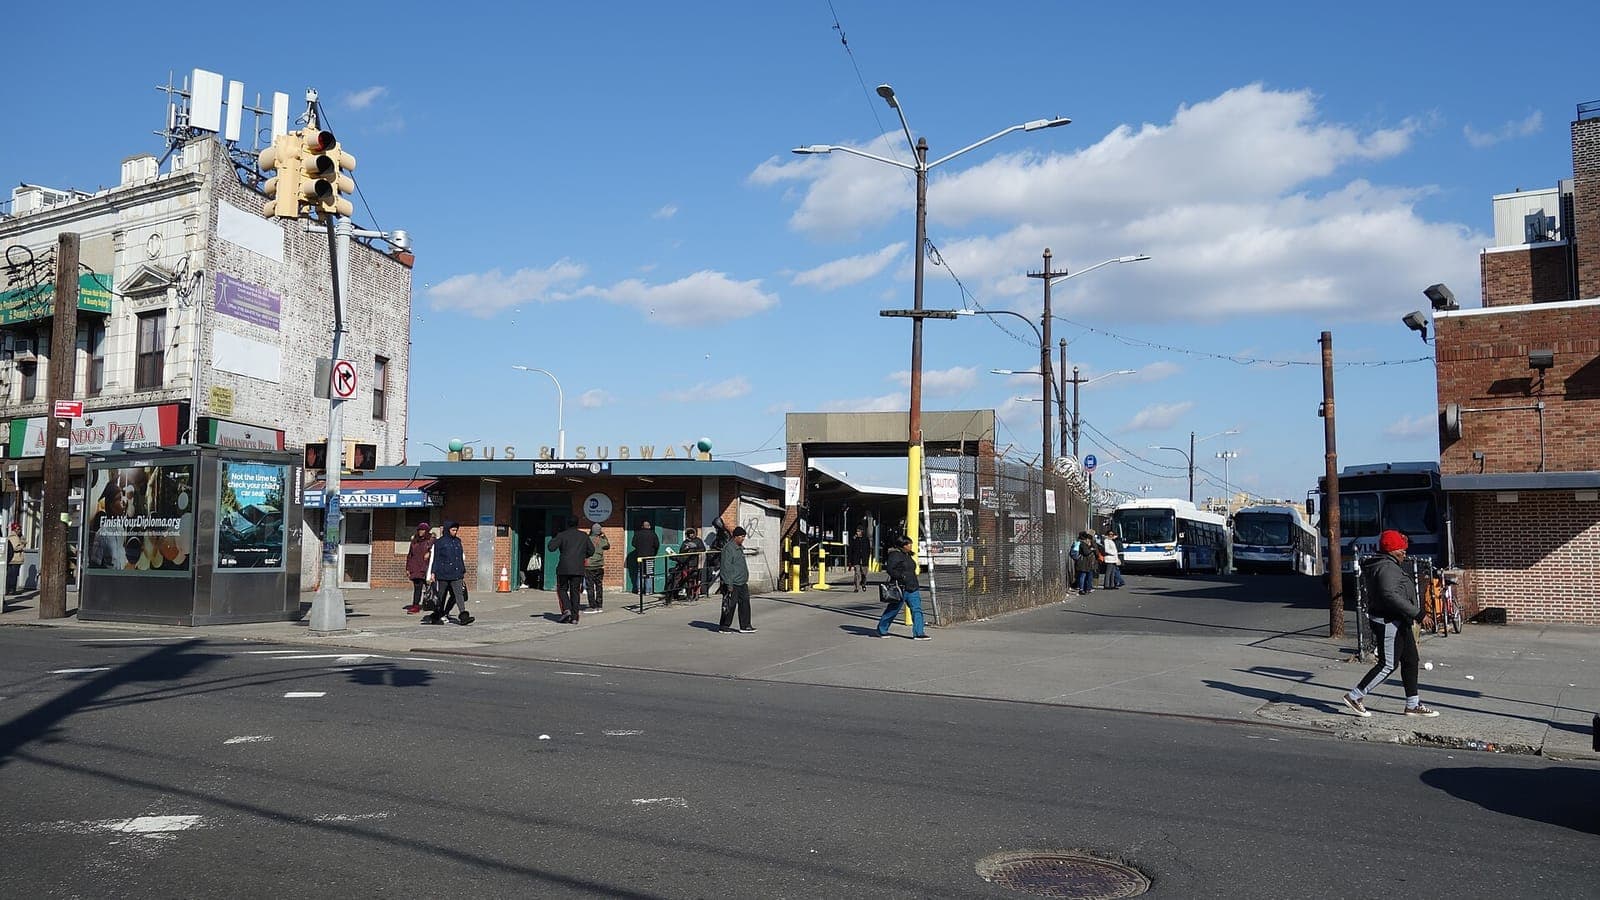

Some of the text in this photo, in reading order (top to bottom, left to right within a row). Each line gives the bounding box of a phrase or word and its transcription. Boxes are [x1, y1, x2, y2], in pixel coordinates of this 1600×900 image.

[107, 421, 145, 441] PIZZA
[463, 444, 695, 460] BUS & SUBWAY
[566, 462, 590, 470] Parkway
[244, 473, 255, 481] the
[255, 474, 269, 482] time
[932, 477, 957, 488] CAUTION
[227, 480, 280, 490] check your child's
[340, 494, 393, 503] RANSIT
[100, 516, 181, 529] FinishYourDiploma.org
